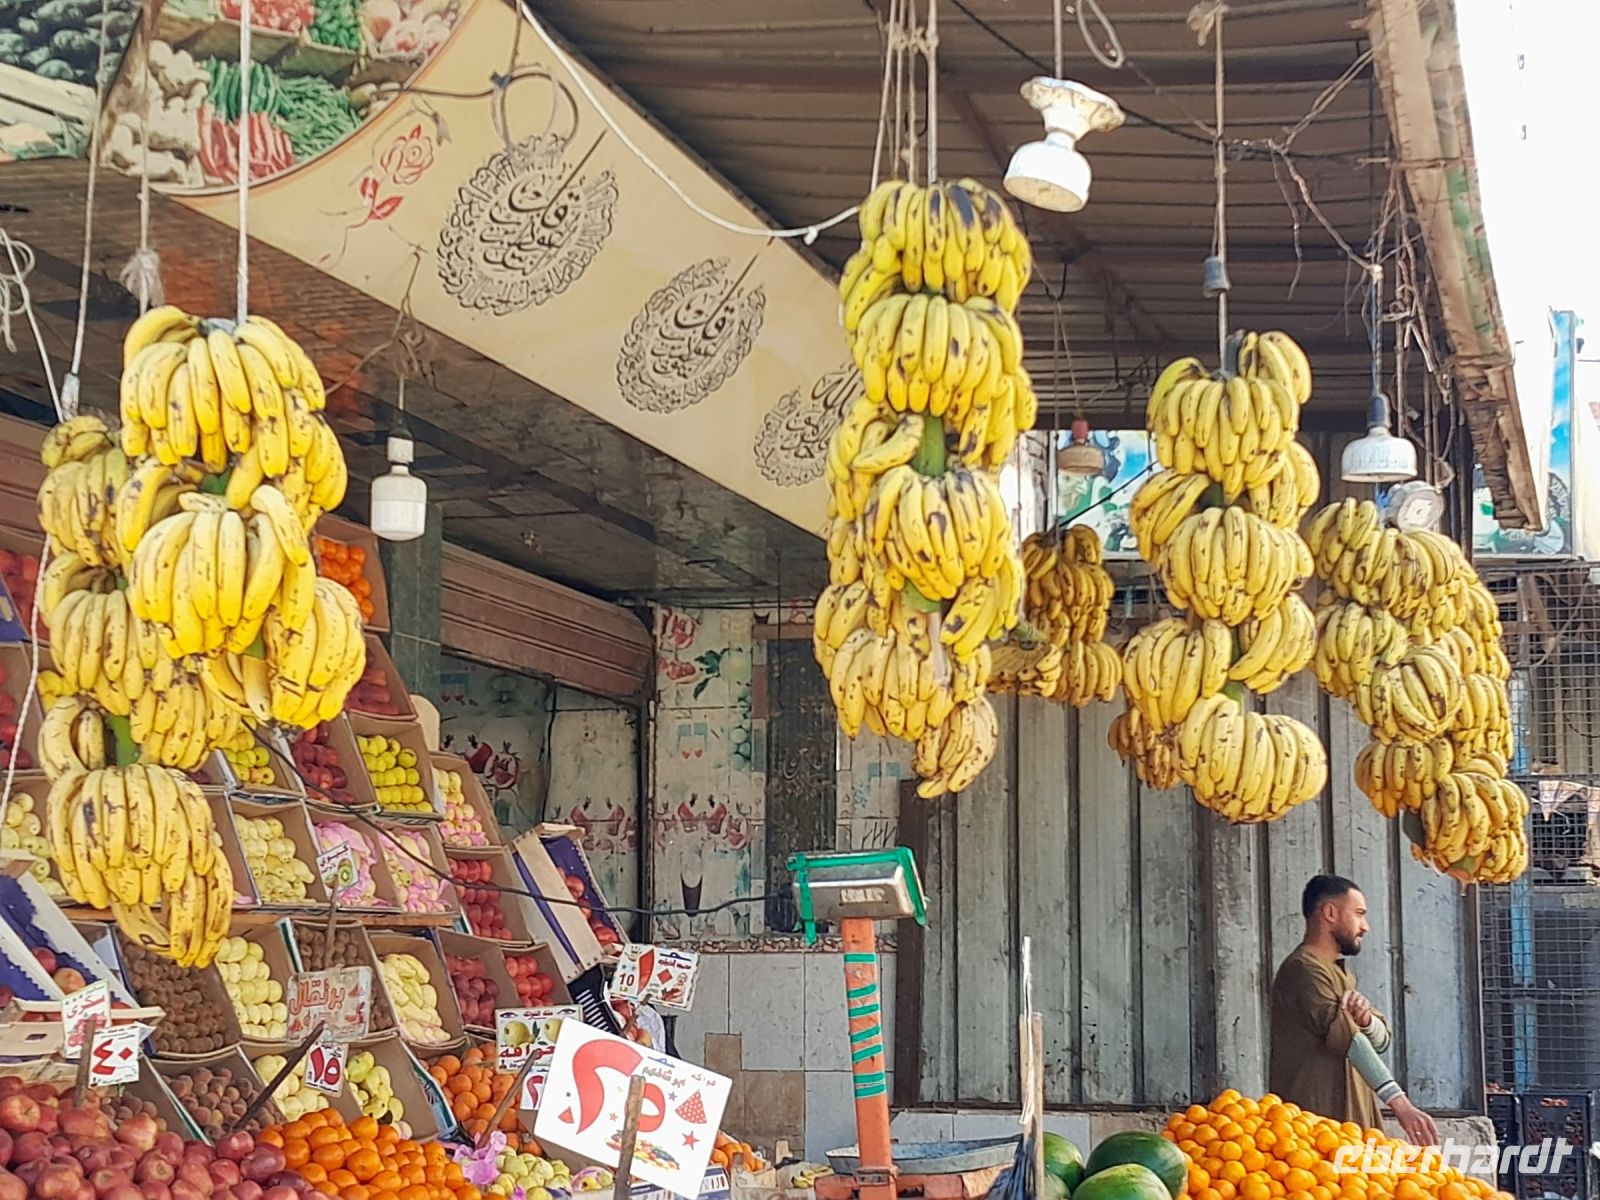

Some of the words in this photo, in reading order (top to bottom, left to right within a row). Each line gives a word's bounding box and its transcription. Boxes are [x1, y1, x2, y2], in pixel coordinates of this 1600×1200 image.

[619, 973, 635, 987] 10
[92, 1038, 133, 1075] ٤٠
[310, 1047, 340, 1085] ١٥
[572, 1038, 666, 1136] ٢٥
